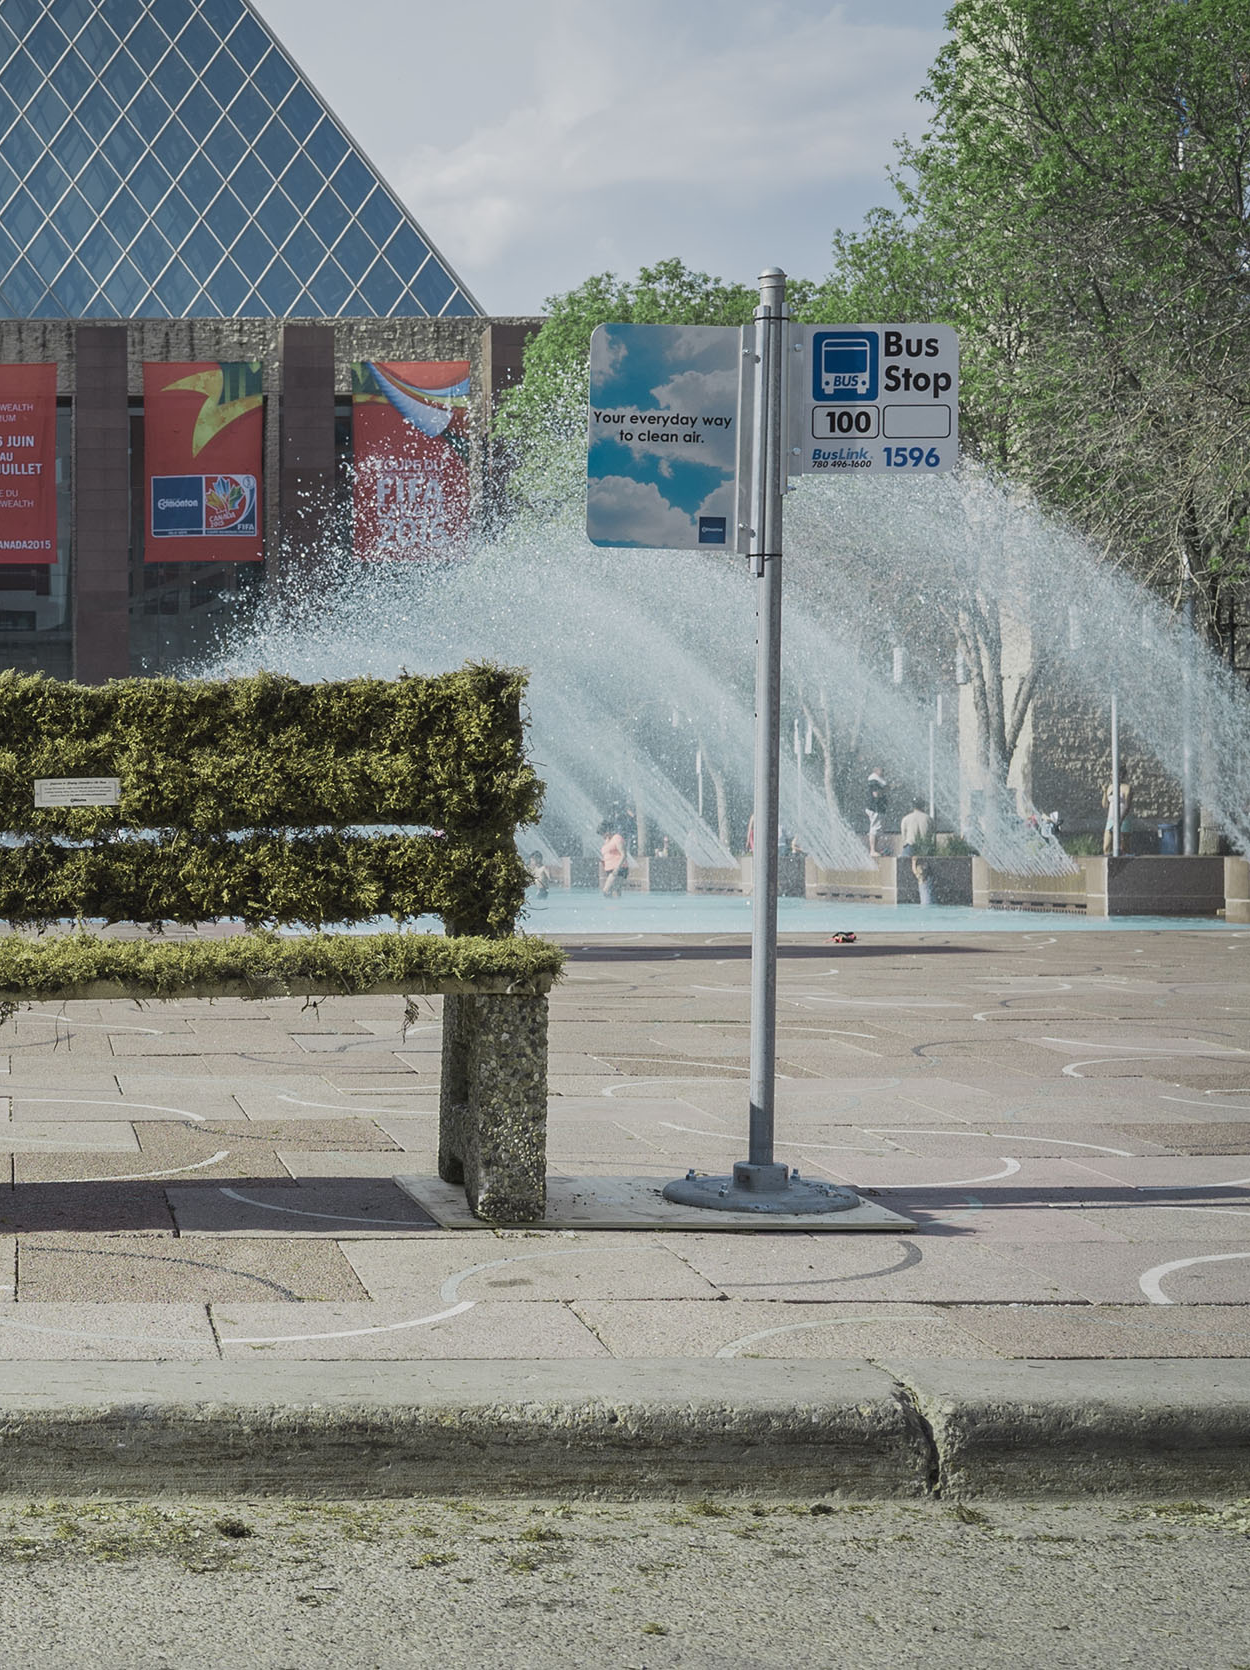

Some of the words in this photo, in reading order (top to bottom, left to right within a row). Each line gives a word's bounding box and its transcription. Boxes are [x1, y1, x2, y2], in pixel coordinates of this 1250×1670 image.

[884, 331, 939, 358] Bus
[833, 375, 859, 387] BUS
[884, 365, 952, 398] Stop
[593, 411, 625, 424] Your
[630, 413, 698, 428] everyday
[702, 416, 732, 429] way
[826, 411, 871, 433] 100
[7, 436, 34, 447] JUIN
[619, 430, 633, 441] to
[638, 430, 679, 442] clean
[683, 431, 705, 443] air.
[812, 447, 869, 460] BusLink
[883, 447, 940, 467] 1596
[812, 460, 829, 468] 780
[831, 460, 872, 468] 496-1600
[6, 489, 18, 497] DU
[377, 479, 444, 503] FIFA
[157, 499, 198, 510] Edmonton
